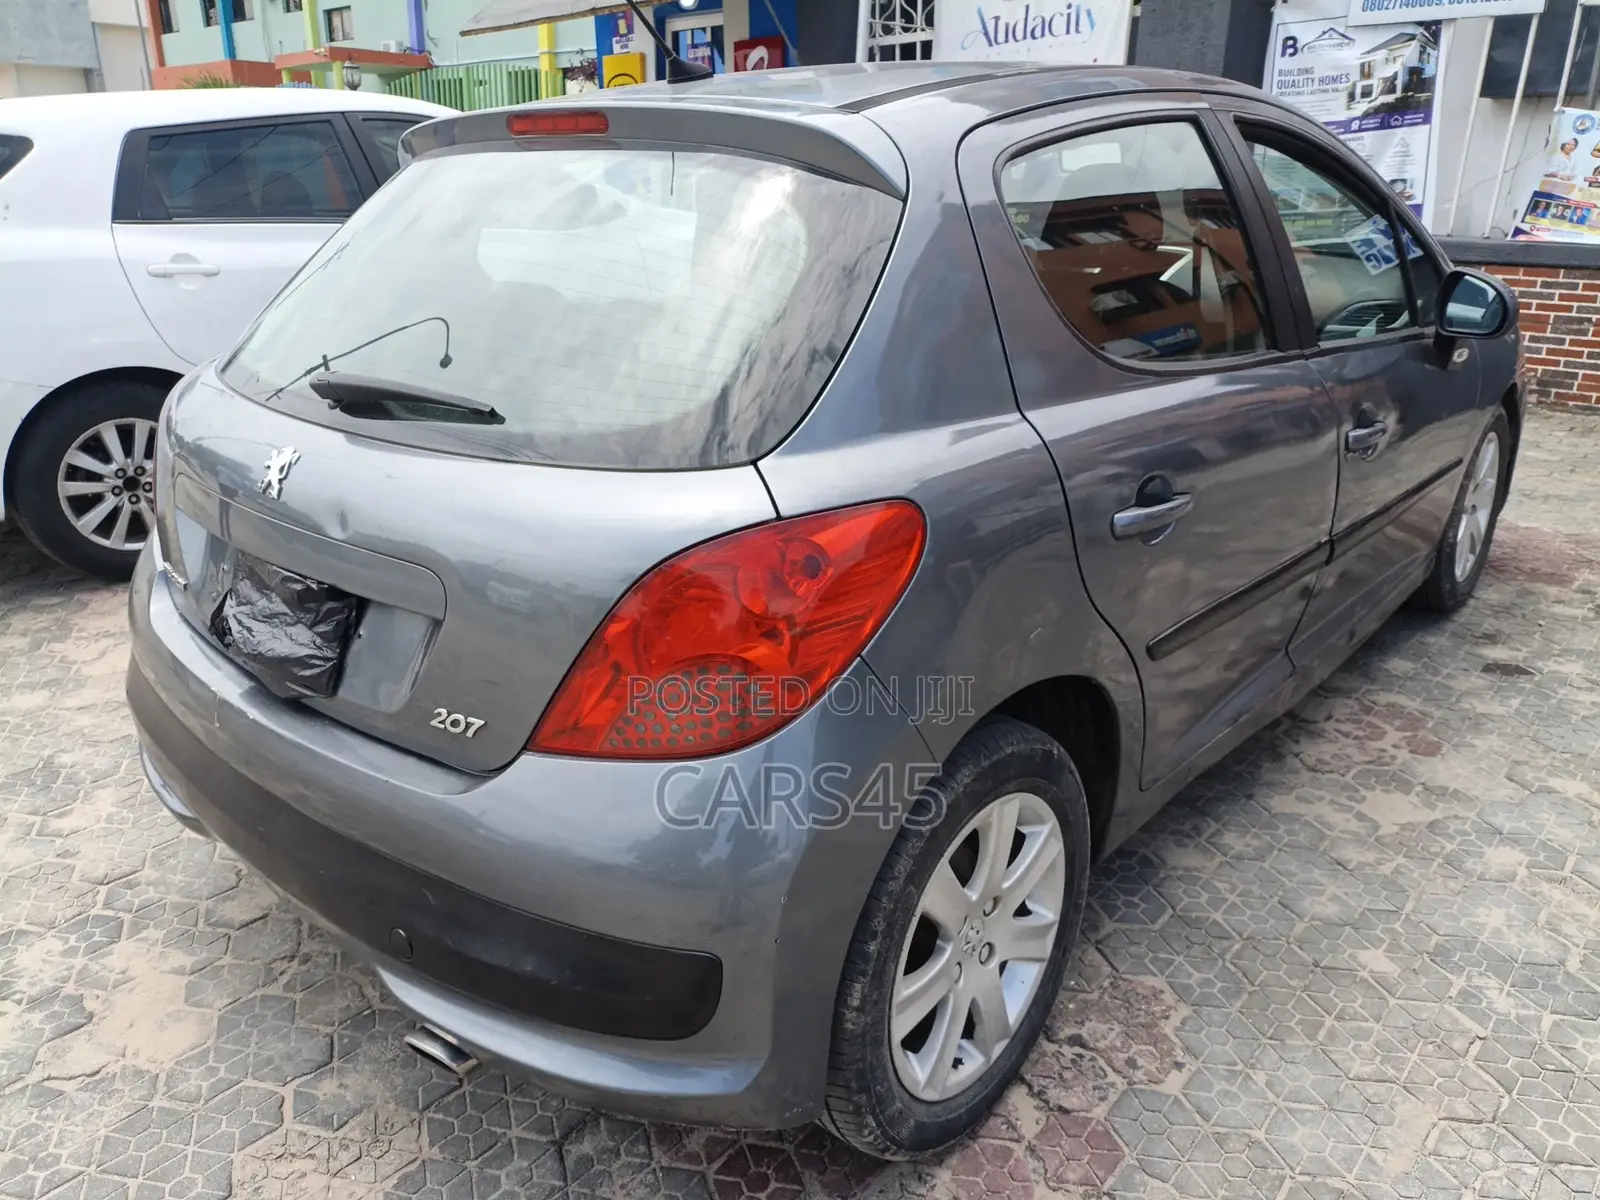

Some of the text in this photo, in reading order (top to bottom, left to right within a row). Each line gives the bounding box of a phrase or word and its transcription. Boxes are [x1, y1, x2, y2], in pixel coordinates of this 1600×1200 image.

[961, 3, 1096, 51] Audacity
[1276, 73, 1351, 90] QUALITY HOMES
[1278, 66, 1315, 77] BUILDING
[429, 708, 486, 738] 207
